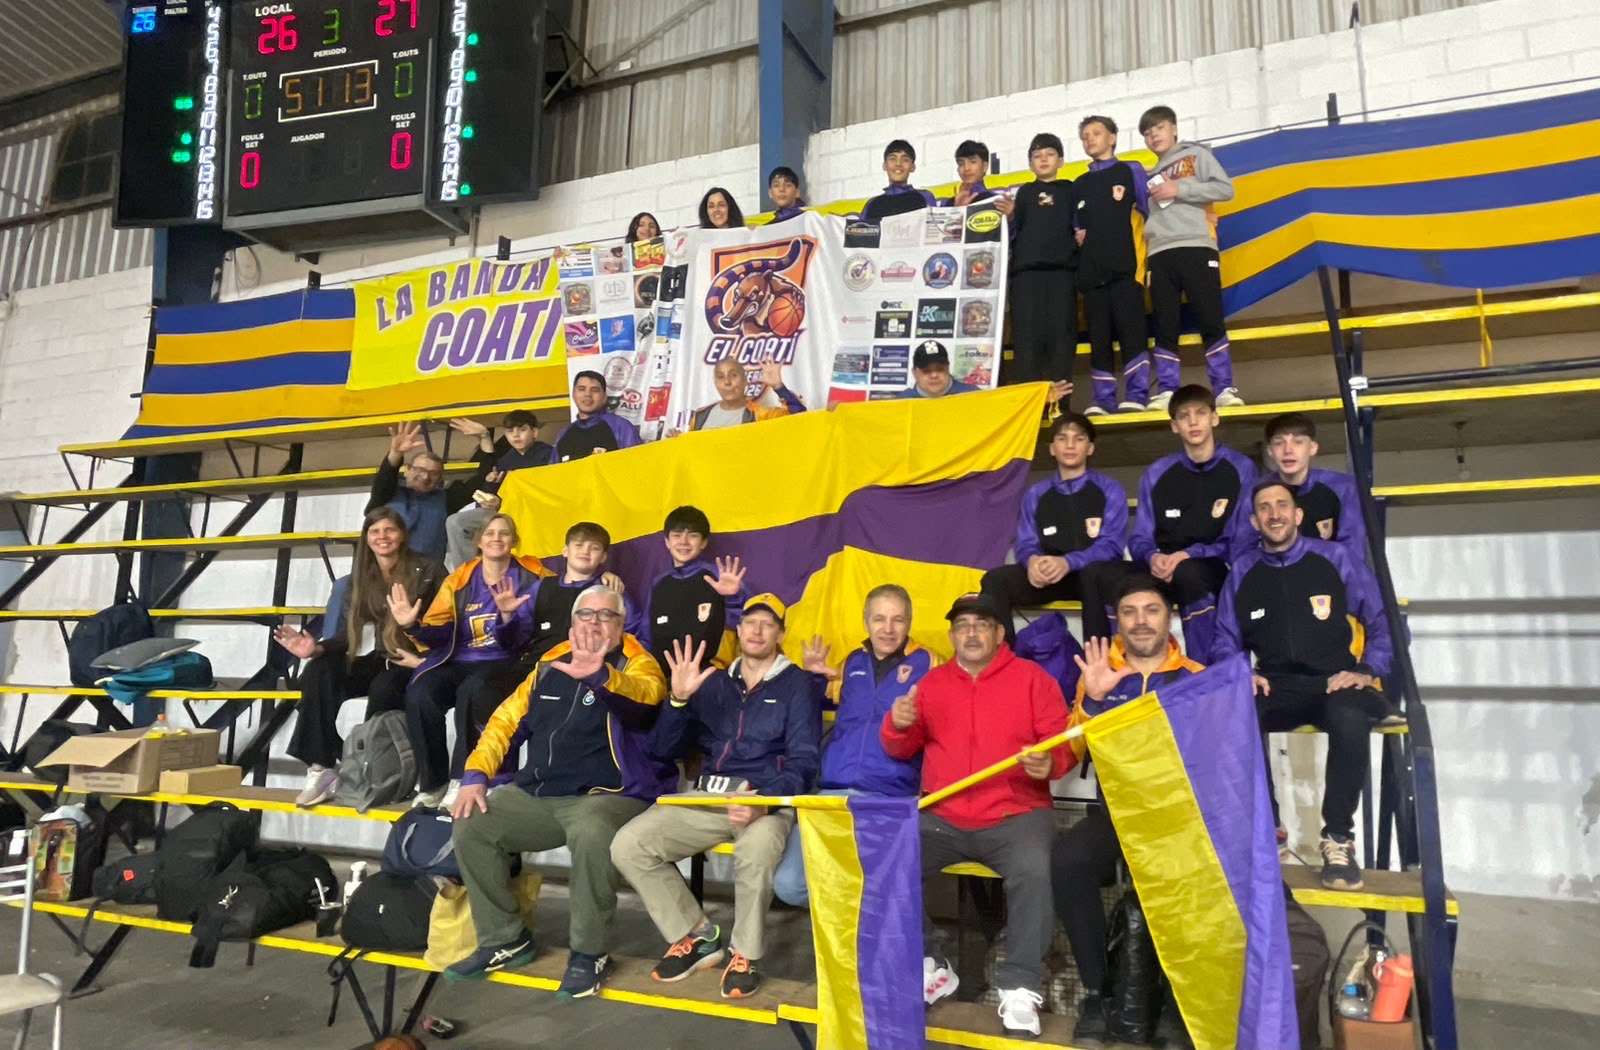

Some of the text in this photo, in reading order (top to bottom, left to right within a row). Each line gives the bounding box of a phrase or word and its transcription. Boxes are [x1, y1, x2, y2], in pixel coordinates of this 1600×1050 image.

[255, 3, 292, 17] LOCAL
[375, 0, 417, 36] 27
[132, 13, 156, 33] 26
[322, 9, 341, 45] 3
[257, 14, 298, 54] 26
[313, 47, 347, 58] PERIODO
[392, 49, 419, 59] T.OUTS
[242, 72, 267, 81] T.OUTS
[394, 62, 414, 98] 0
[244, 84, 262, 119] 0
[391, 112, 416, 122] FOULS
[395, 121, 412, 129] SET
[241, 133, 264, 142] FOULS
[245, 141, 259, 149] SET
[290, 132, 325, 143] JUGADOR
[390, 132, 412, 170] 0
[240, 151, 261, 189] 0
[375, 283, 413, 331] LA
